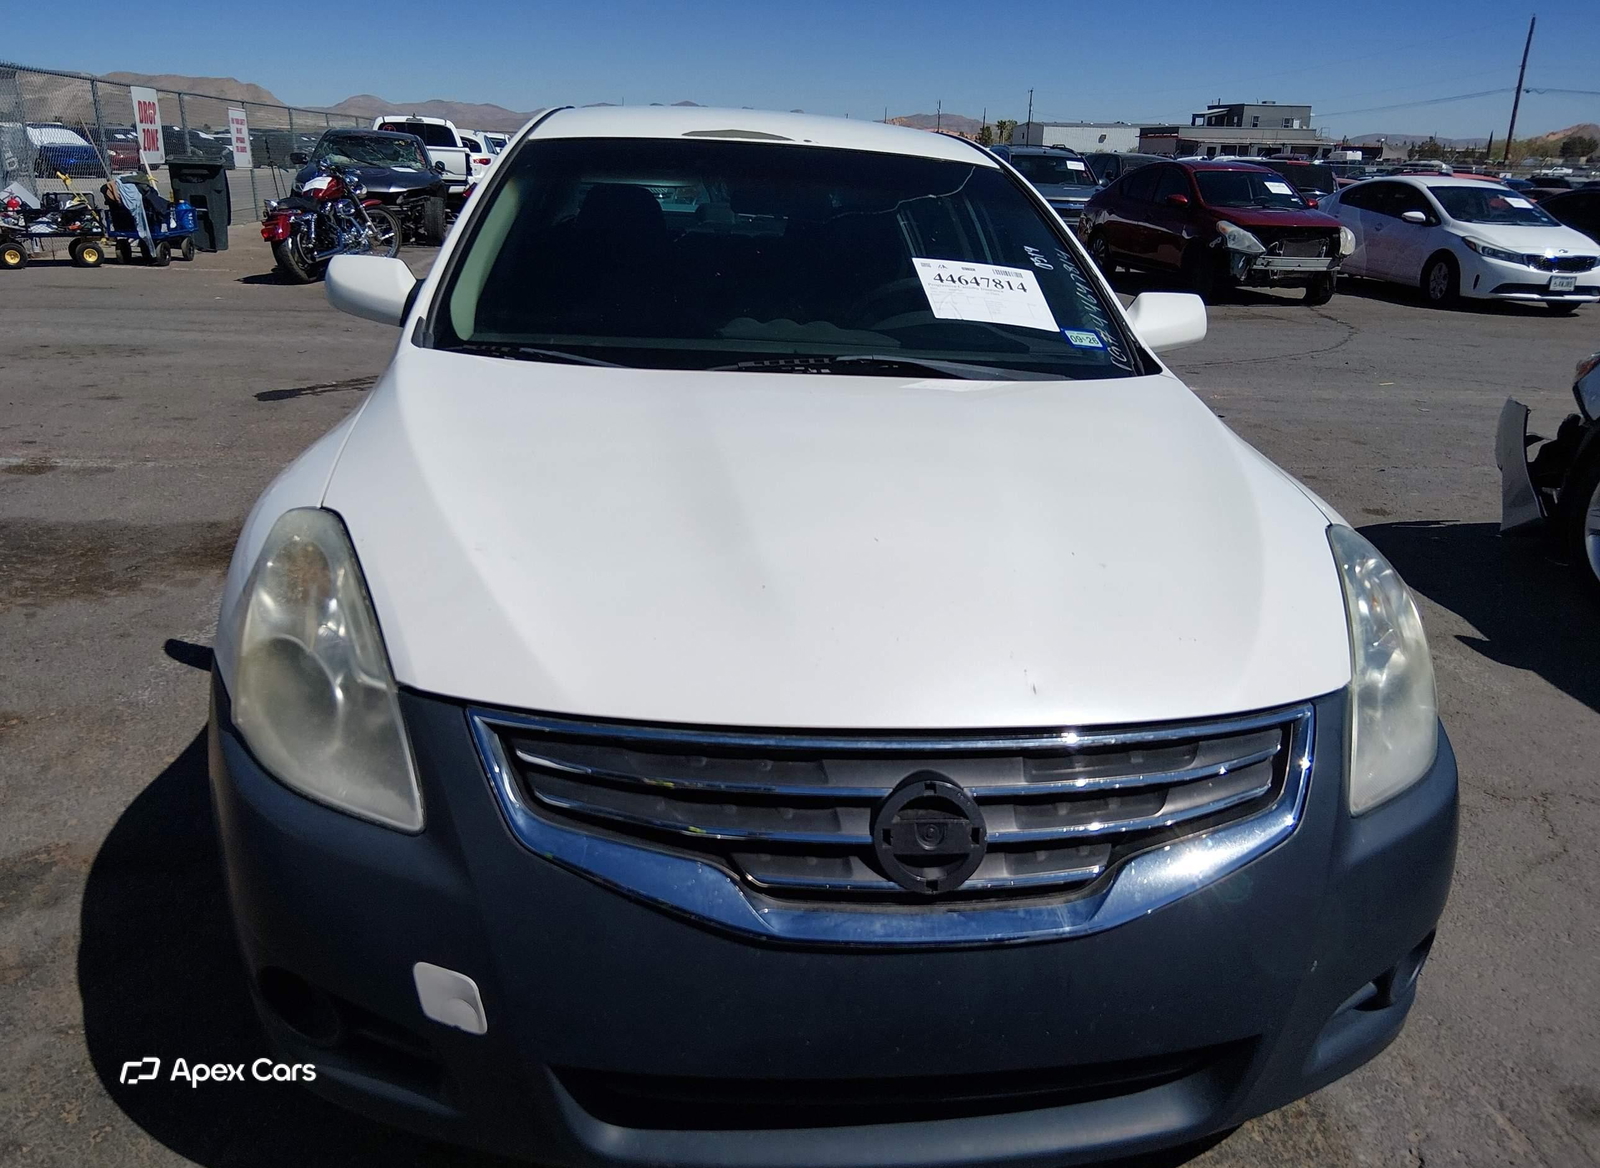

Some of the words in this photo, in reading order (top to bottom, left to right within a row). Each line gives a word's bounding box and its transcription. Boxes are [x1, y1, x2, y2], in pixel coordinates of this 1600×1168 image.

[137, 100, 156, 125] DROP
[142, 128, 159, 152] ZONE
[933, 273, 1028, 293] 44647814
